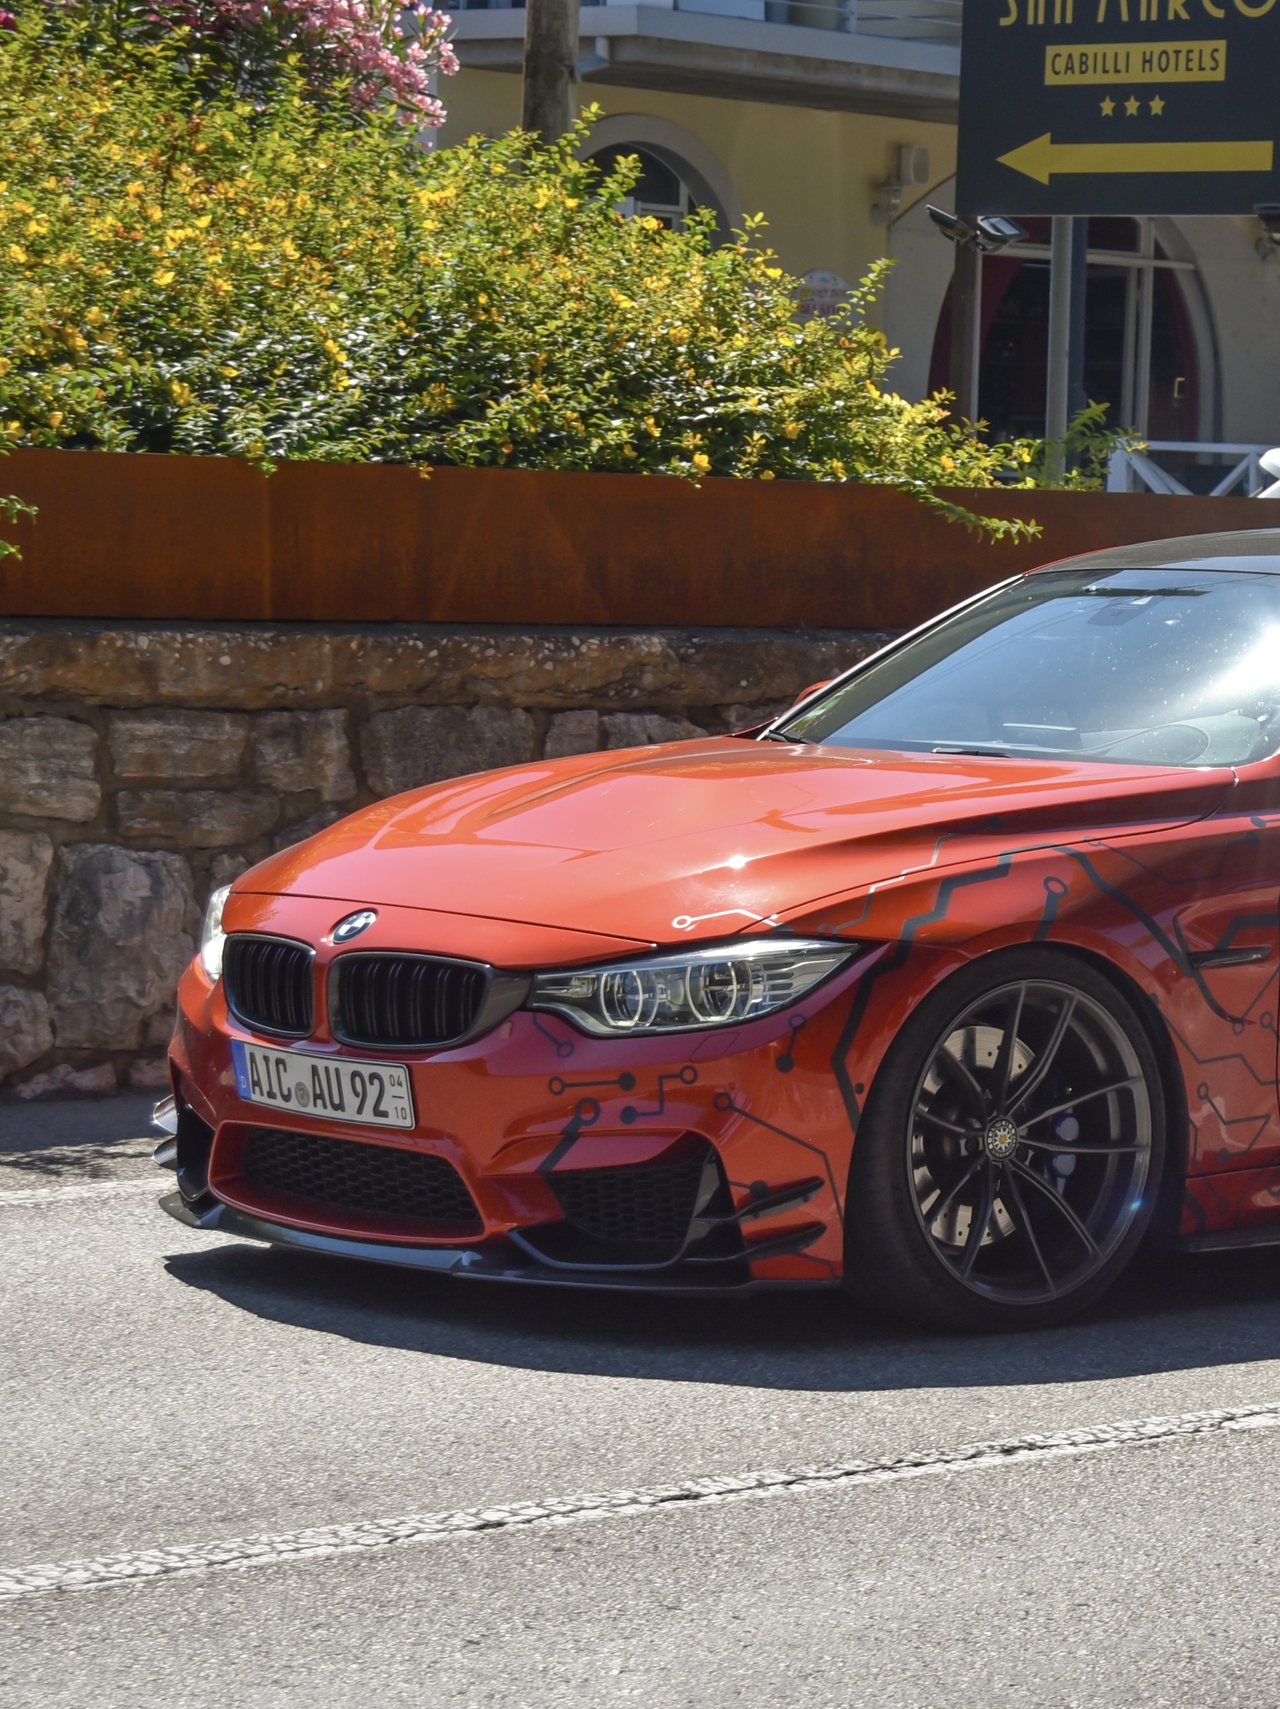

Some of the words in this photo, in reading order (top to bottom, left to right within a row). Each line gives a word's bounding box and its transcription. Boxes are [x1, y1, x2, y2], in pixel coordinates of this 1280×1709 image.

[1051, 51, 1130, 75] CABILLI
[1141, 48, 1220, 73] HOTELS
[240, 1075, 247, 1088] D
[249, 1052, 292, 1103] AIC
[311, 1064, 345, 1112] AU
[350, 1070, 390, 1118] 92
[389, 1074, 403, 1088] 04
[394, 1106, 407, 1120] 10
